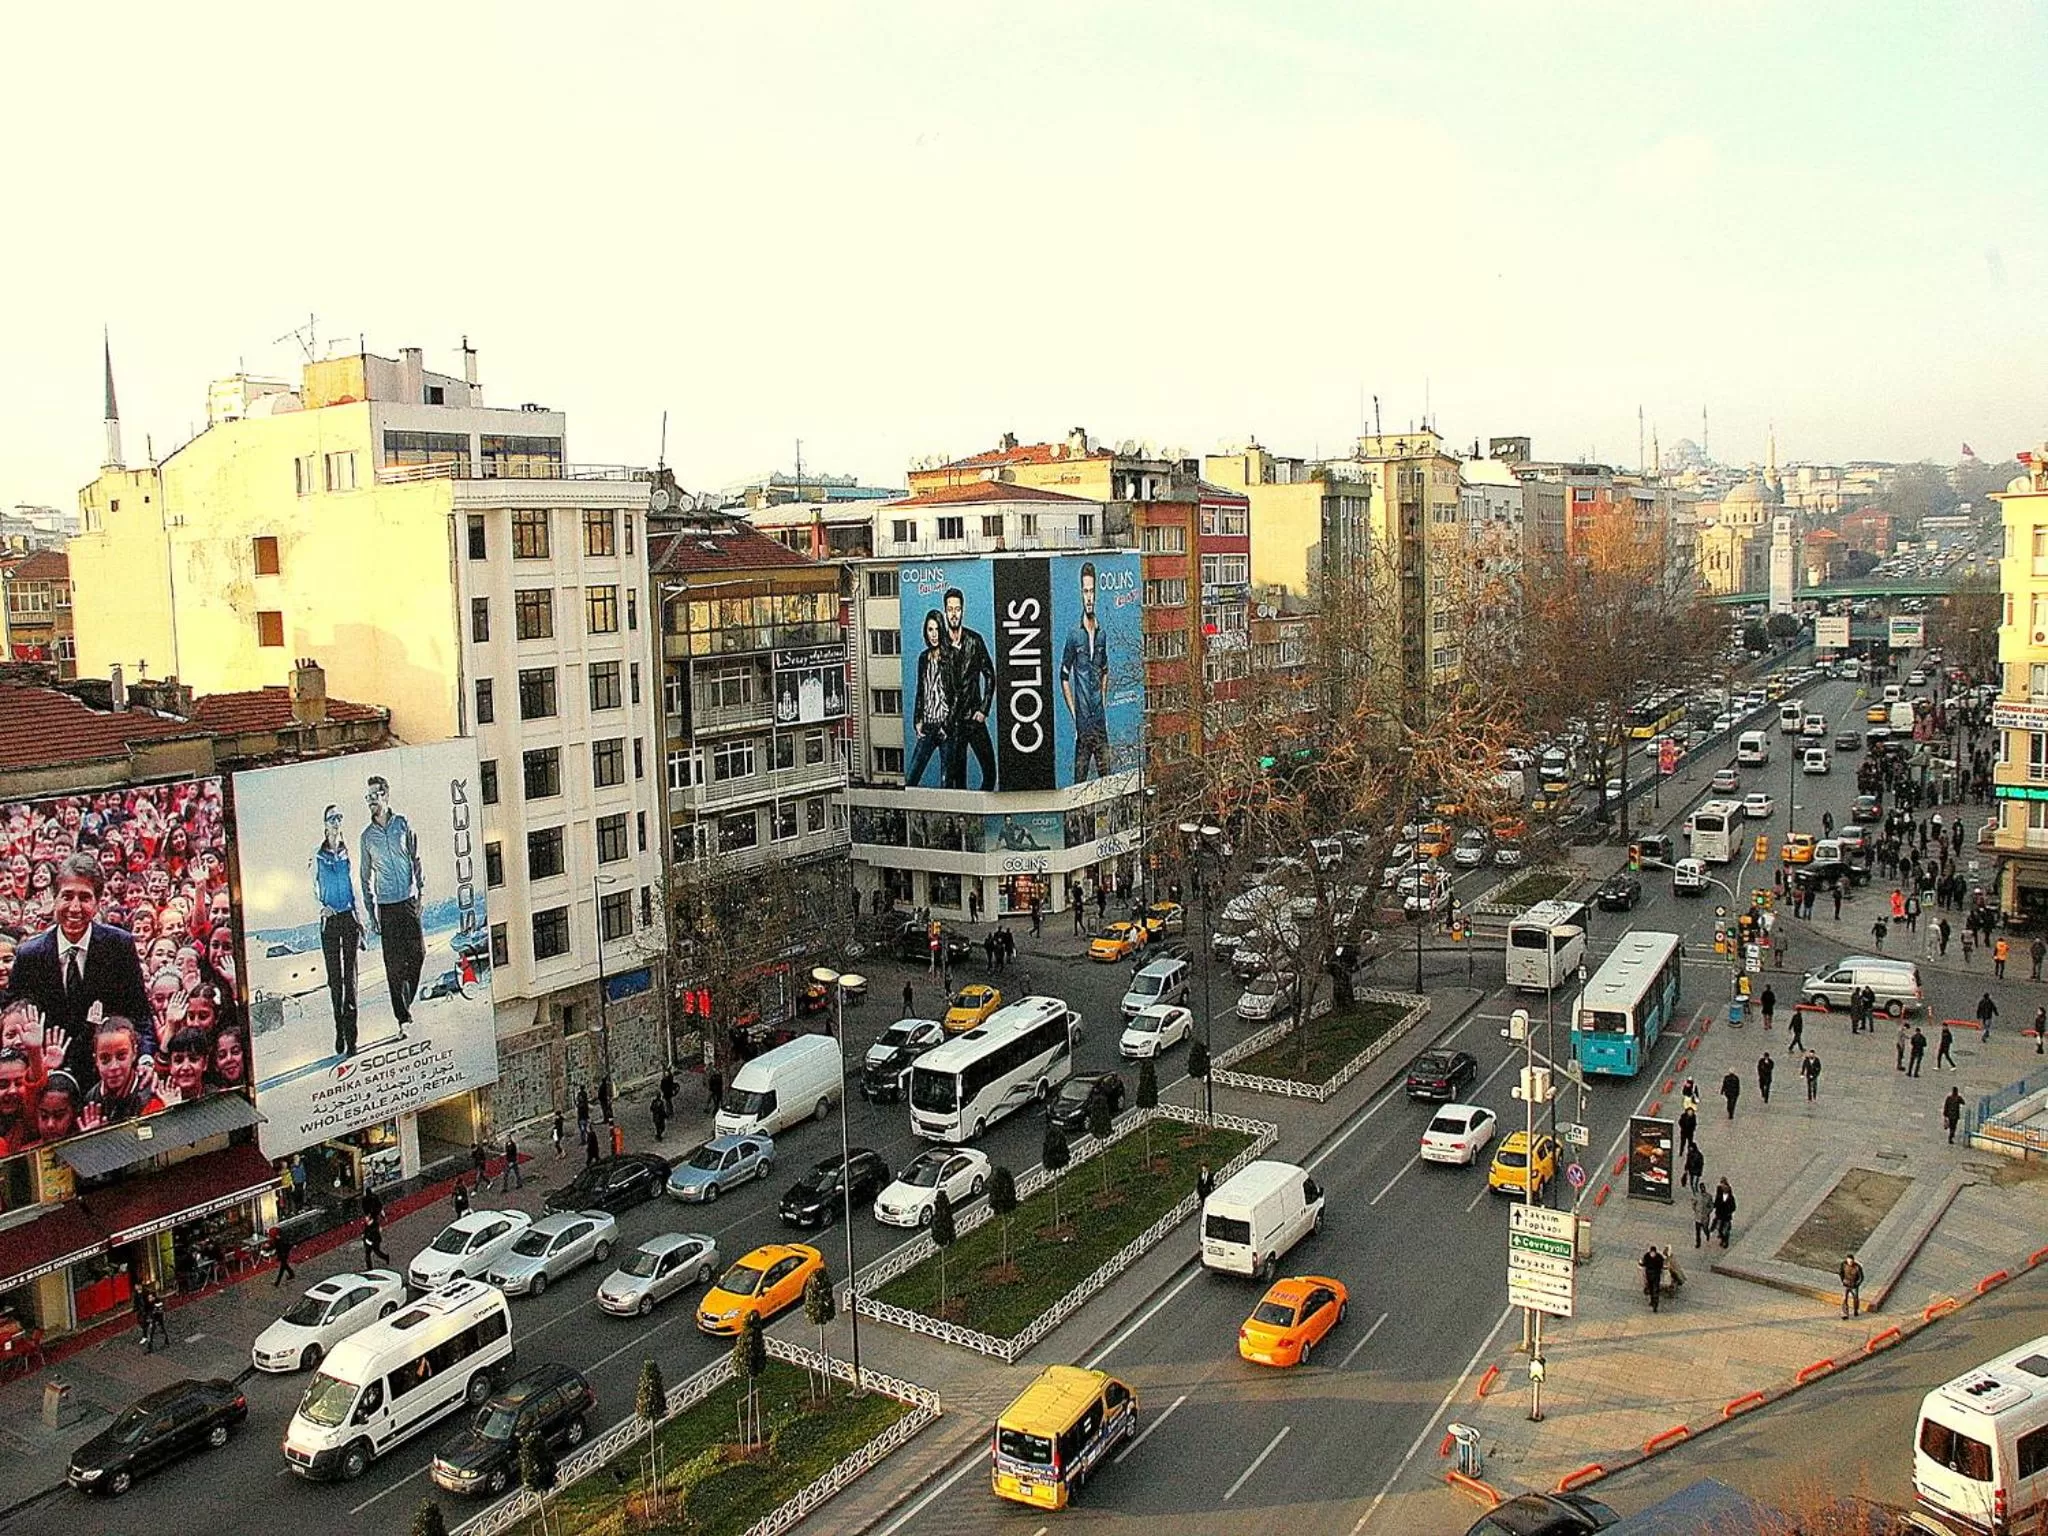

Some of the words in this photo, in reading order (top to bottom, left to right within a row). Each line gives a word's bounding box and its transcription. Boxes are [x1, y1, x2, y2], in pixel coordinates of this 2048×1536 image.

[1002, 597, 1044, 753] COLIN'S
[450, 777, 477, 938] SOCCER
[1003, 856, 1049, 872] COLIN'S
[360, 1039, 433, 1072] SOCCER
[311, 1079, 362, 1101] FABRİKA
[364, 1068, 396, 1085] SATIŞ
[413, 1049, 454, 1068] OUTLET
[299, 1097, 388, 1134] WHOLESALE
[391, 1087, 419, 1105] AND
[422, 1072, 467, 1093] RETAIL
[1524, 1209, 1559, 1223] Taksim
[1524, 1219, 1562, 1234] Topkapı
[1513, 1254, 1555, 1271] Beyazıt
